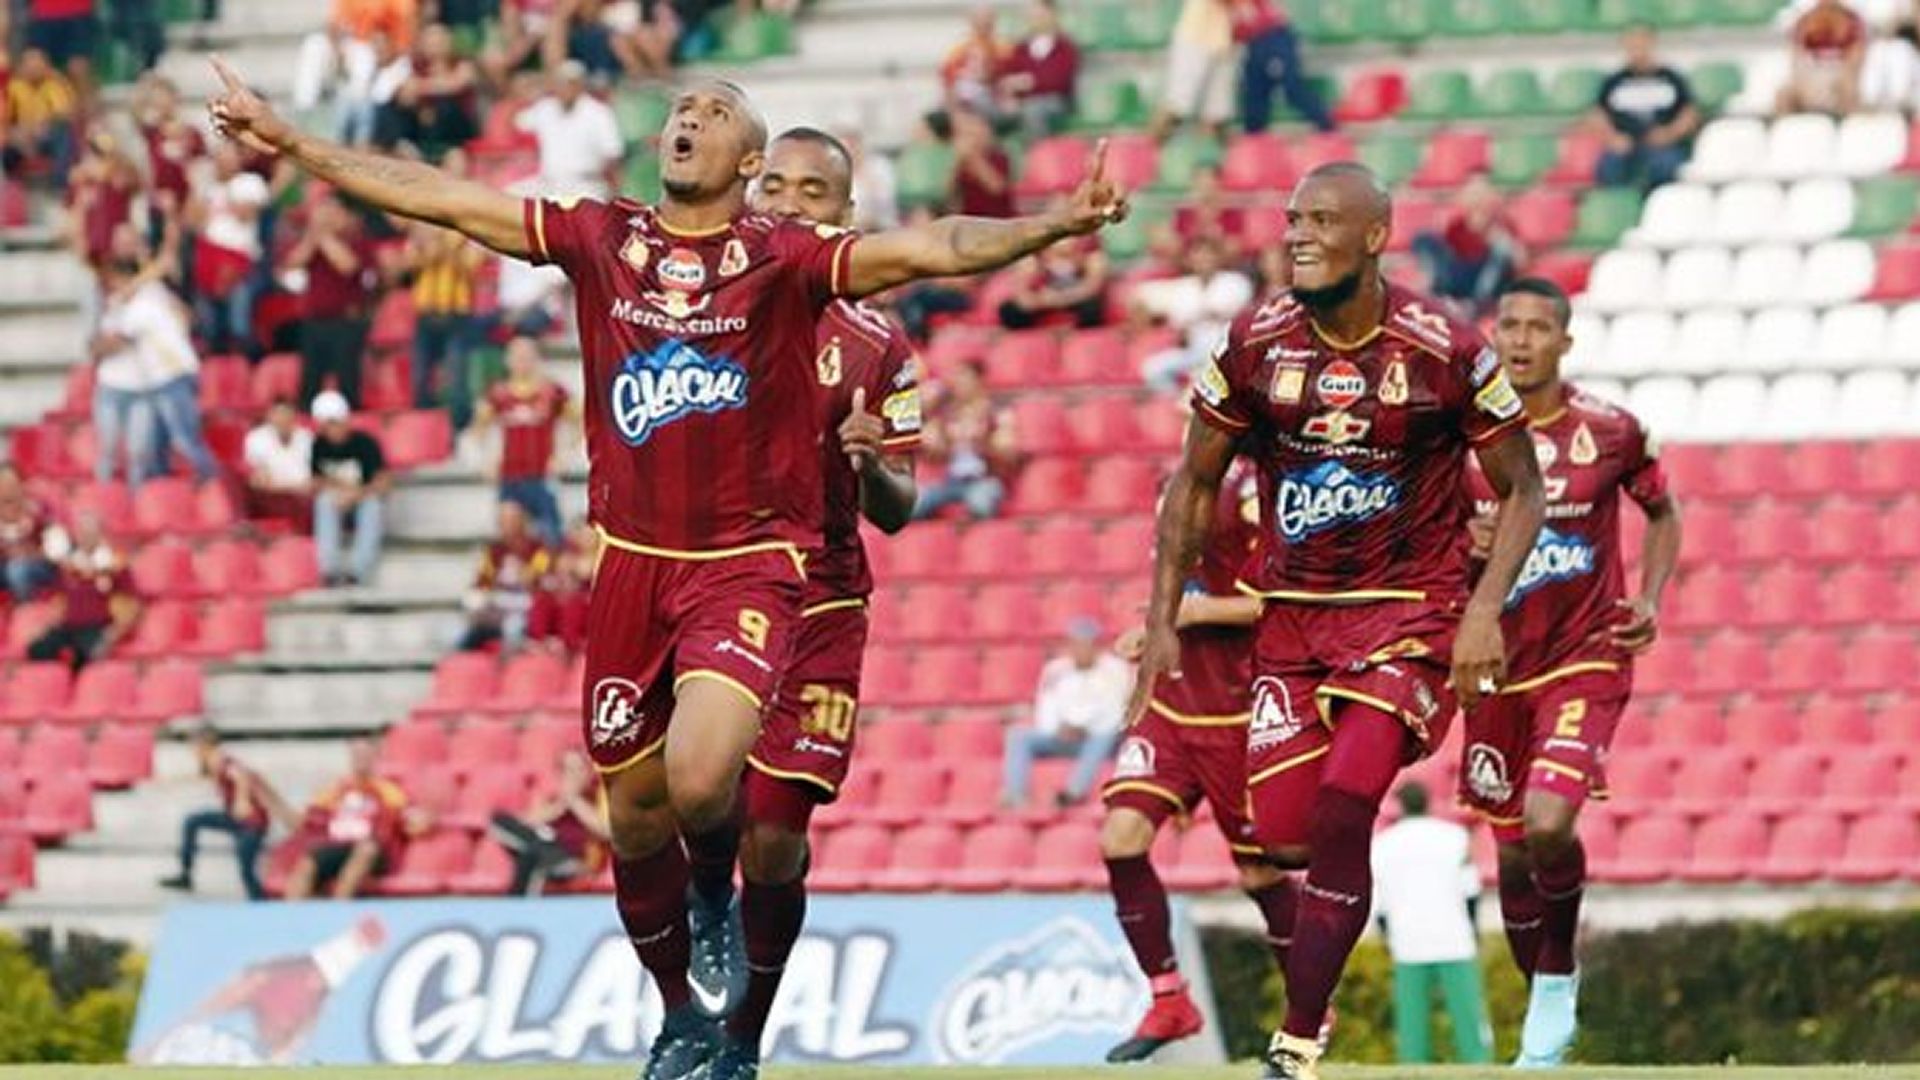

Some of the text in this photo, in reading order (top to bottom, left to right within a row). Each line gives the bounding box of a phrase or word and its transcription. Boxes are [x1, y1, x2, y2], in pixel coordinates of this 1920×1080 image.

[611, 366, 745, 440] GLACIAL
[1320, 376, 1362, 391] Gulf
[738, 609, 770, 651] 9
[800, 684, 856, 742] 30
[1554, 698, 1586, 737] 2
[373, 924, 910, 1064] GLAAL
